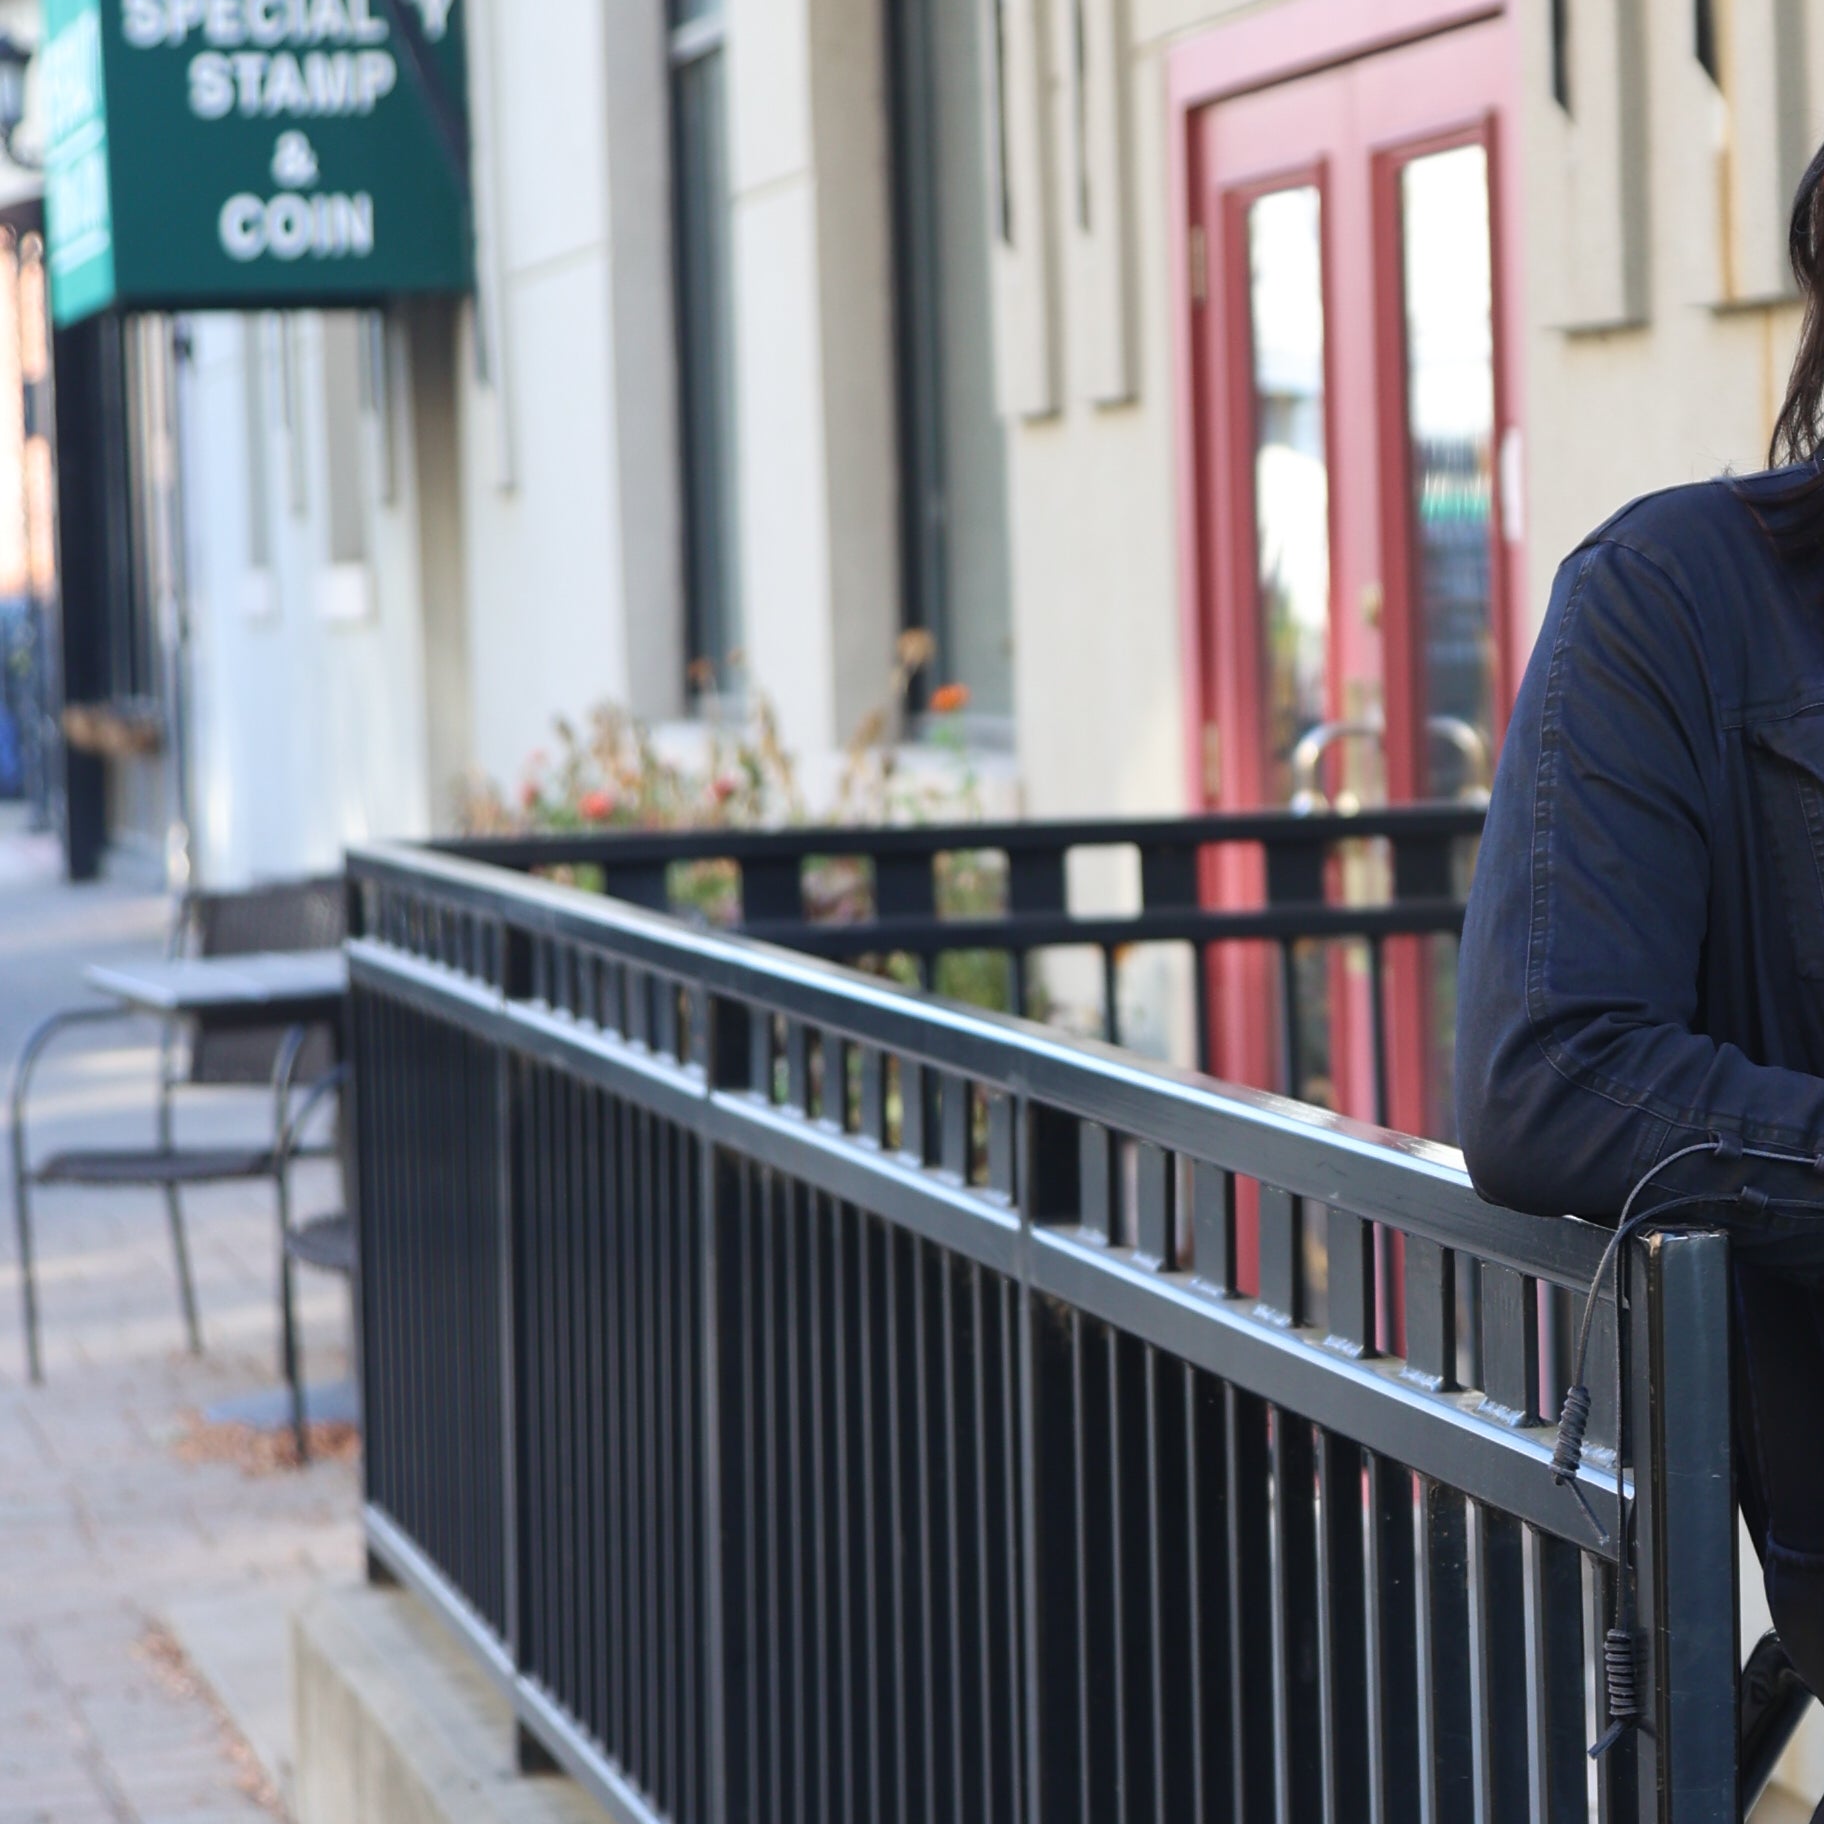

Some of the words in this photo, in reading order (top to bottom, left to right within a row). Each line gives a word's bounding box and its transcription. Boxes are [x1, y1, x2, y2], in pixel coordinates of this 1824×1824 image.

[188, 50, 396, 119] STAMP
[271, 130, 320, 188] &
[218, 191, 374, 261] COIN
